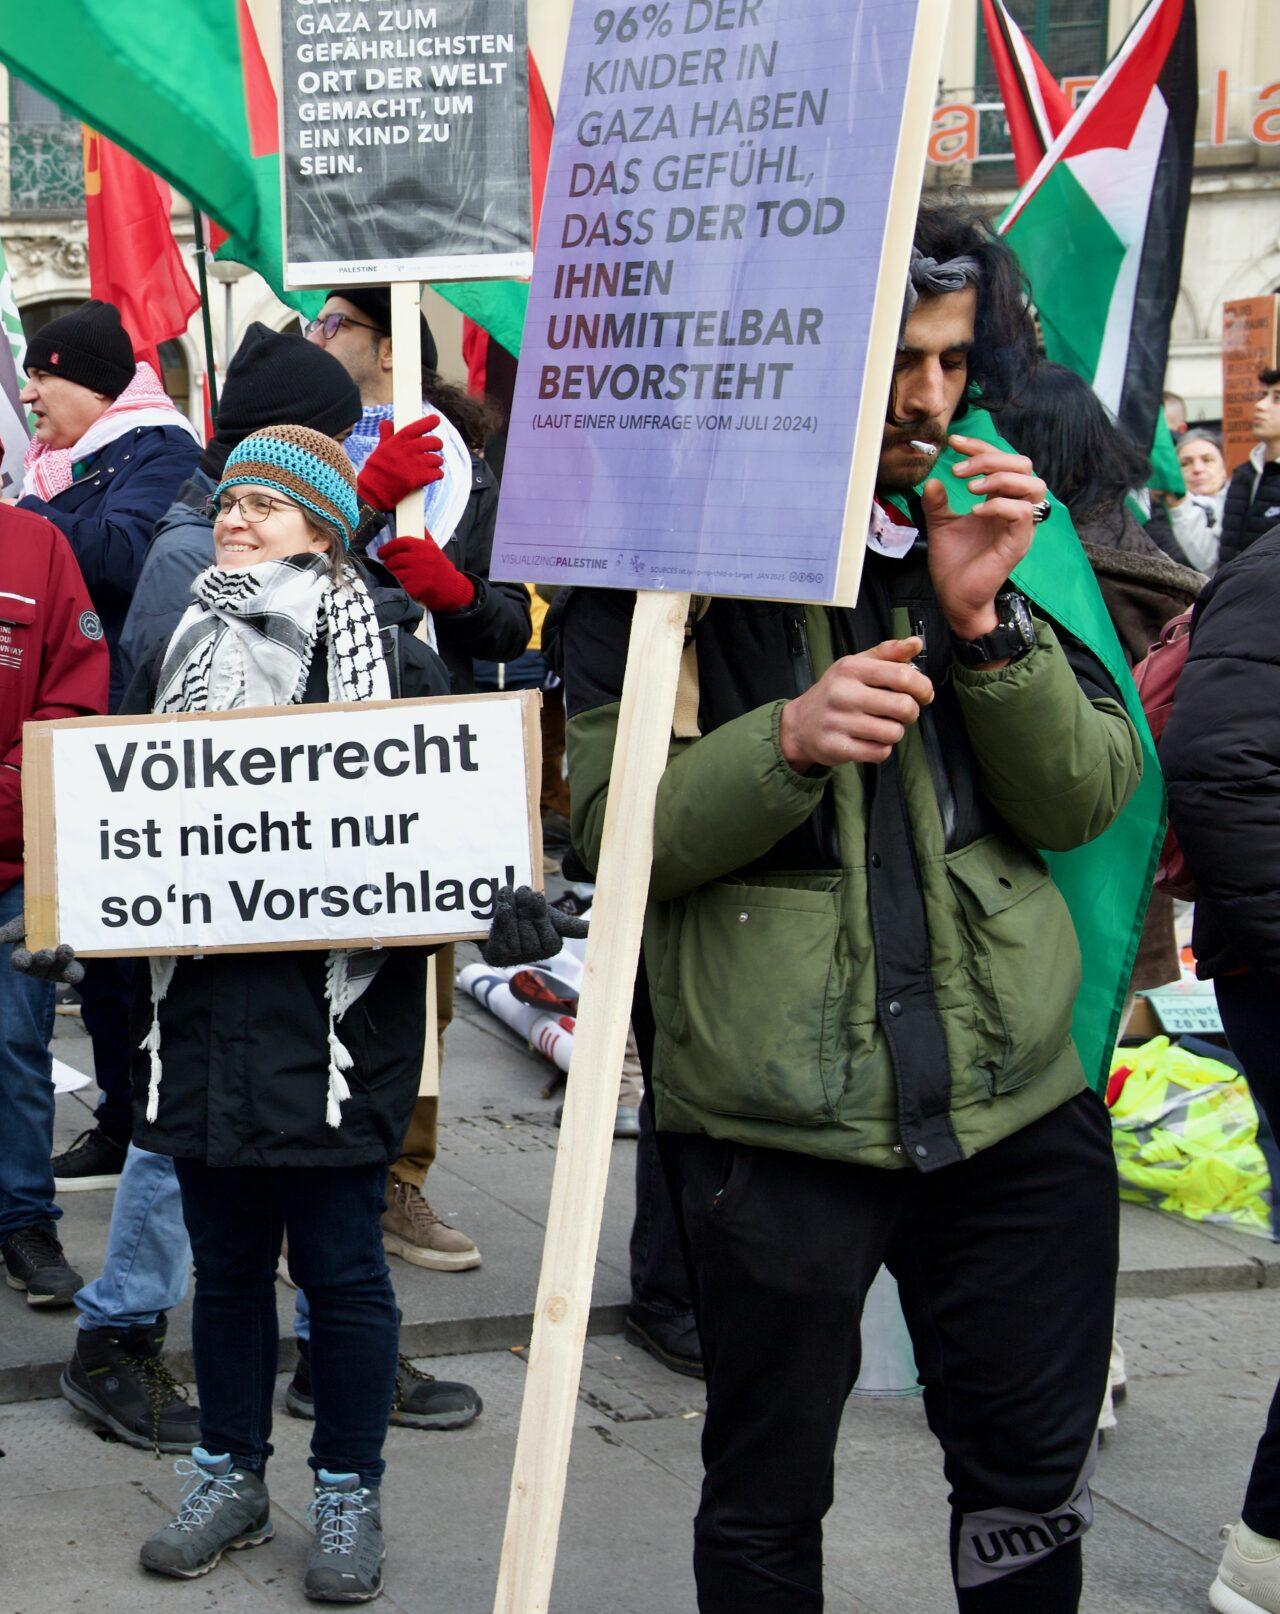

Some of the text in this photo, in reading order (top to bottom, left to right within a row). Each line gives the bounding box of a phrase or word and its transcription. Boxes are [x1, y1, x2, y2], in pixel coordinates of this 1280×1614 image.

[296, 8, 437, 35] GAZA ZUM
[593, 0, 762, 46] 96% DER
[297, 34, 514, 63] GEFÄHRLICHSTEN
[298, 63, 507, 94] ORT DER WELT
[584, 40, 778, 97] KINDER IN
[298, 95, 473, 122] GEMACHT, UM
[577, 88, 829, 147] GAZA HABEN
[299, 123, 449, 149] EIN KIND ZU
[299, 155, 363, 176] SEIN.
[568, 140, 815, 198] DAS GEFÜHL,
[561, 197, 846, 249] DASS DER TOD
[553, 260, 674, 299] IHNEN
[546, 307, 824, 350] UNMITTELBAR
[538, 363, 793, 400] BEVORSTEHT
[532, 414, 818, 434] (LAUT EINER UMFRAGE VOM JULI 2024)
[95, 724, 479, 793] Völkerrecht
[99, 810, 418, 860] ist nicht nur
